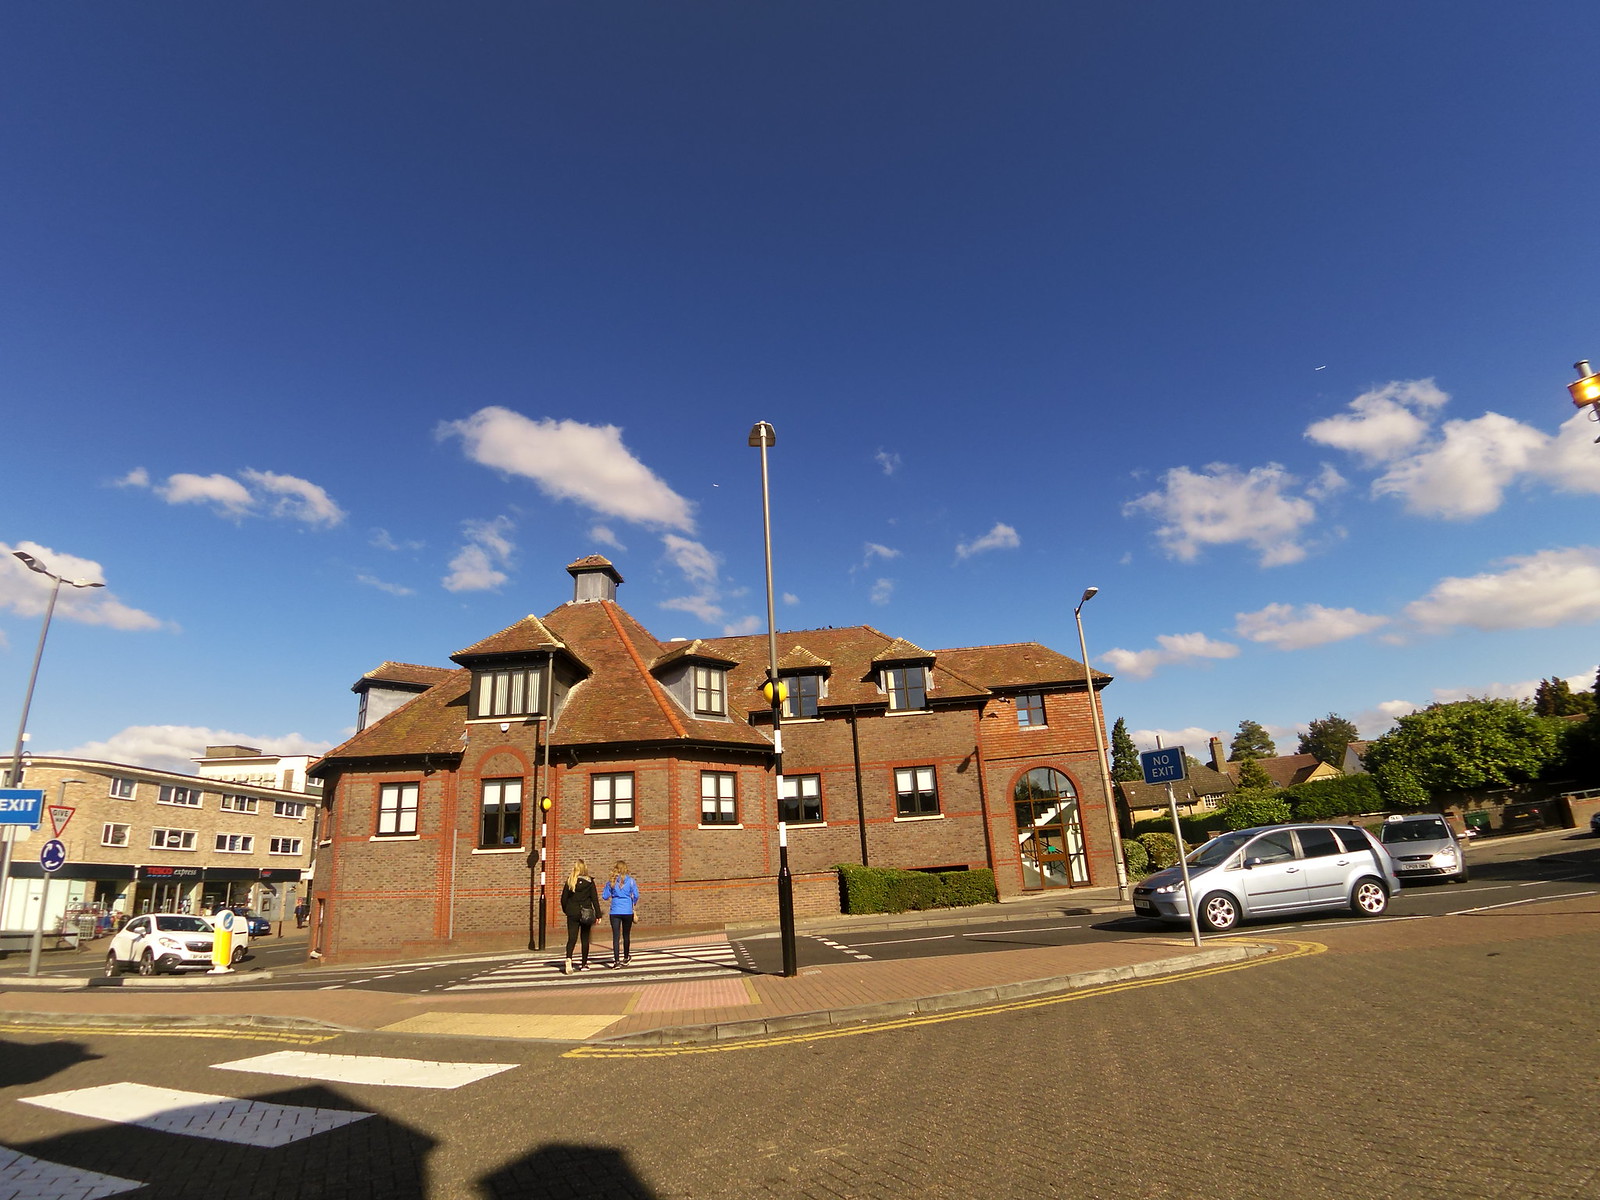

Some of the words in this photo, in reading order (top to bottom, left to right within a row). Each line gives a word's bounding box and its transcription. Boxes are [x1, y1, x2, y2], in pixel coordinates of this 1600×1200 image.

[1152, 754, 1169, 765] NO
[1152, 766, 1174, 778] EXIT
[0, 799, 37, 811] EXIT
[53, 809, 69, 817] GIVE
[146, 867, 173, 875] TESCO
[173, 869, 197, 877] express
